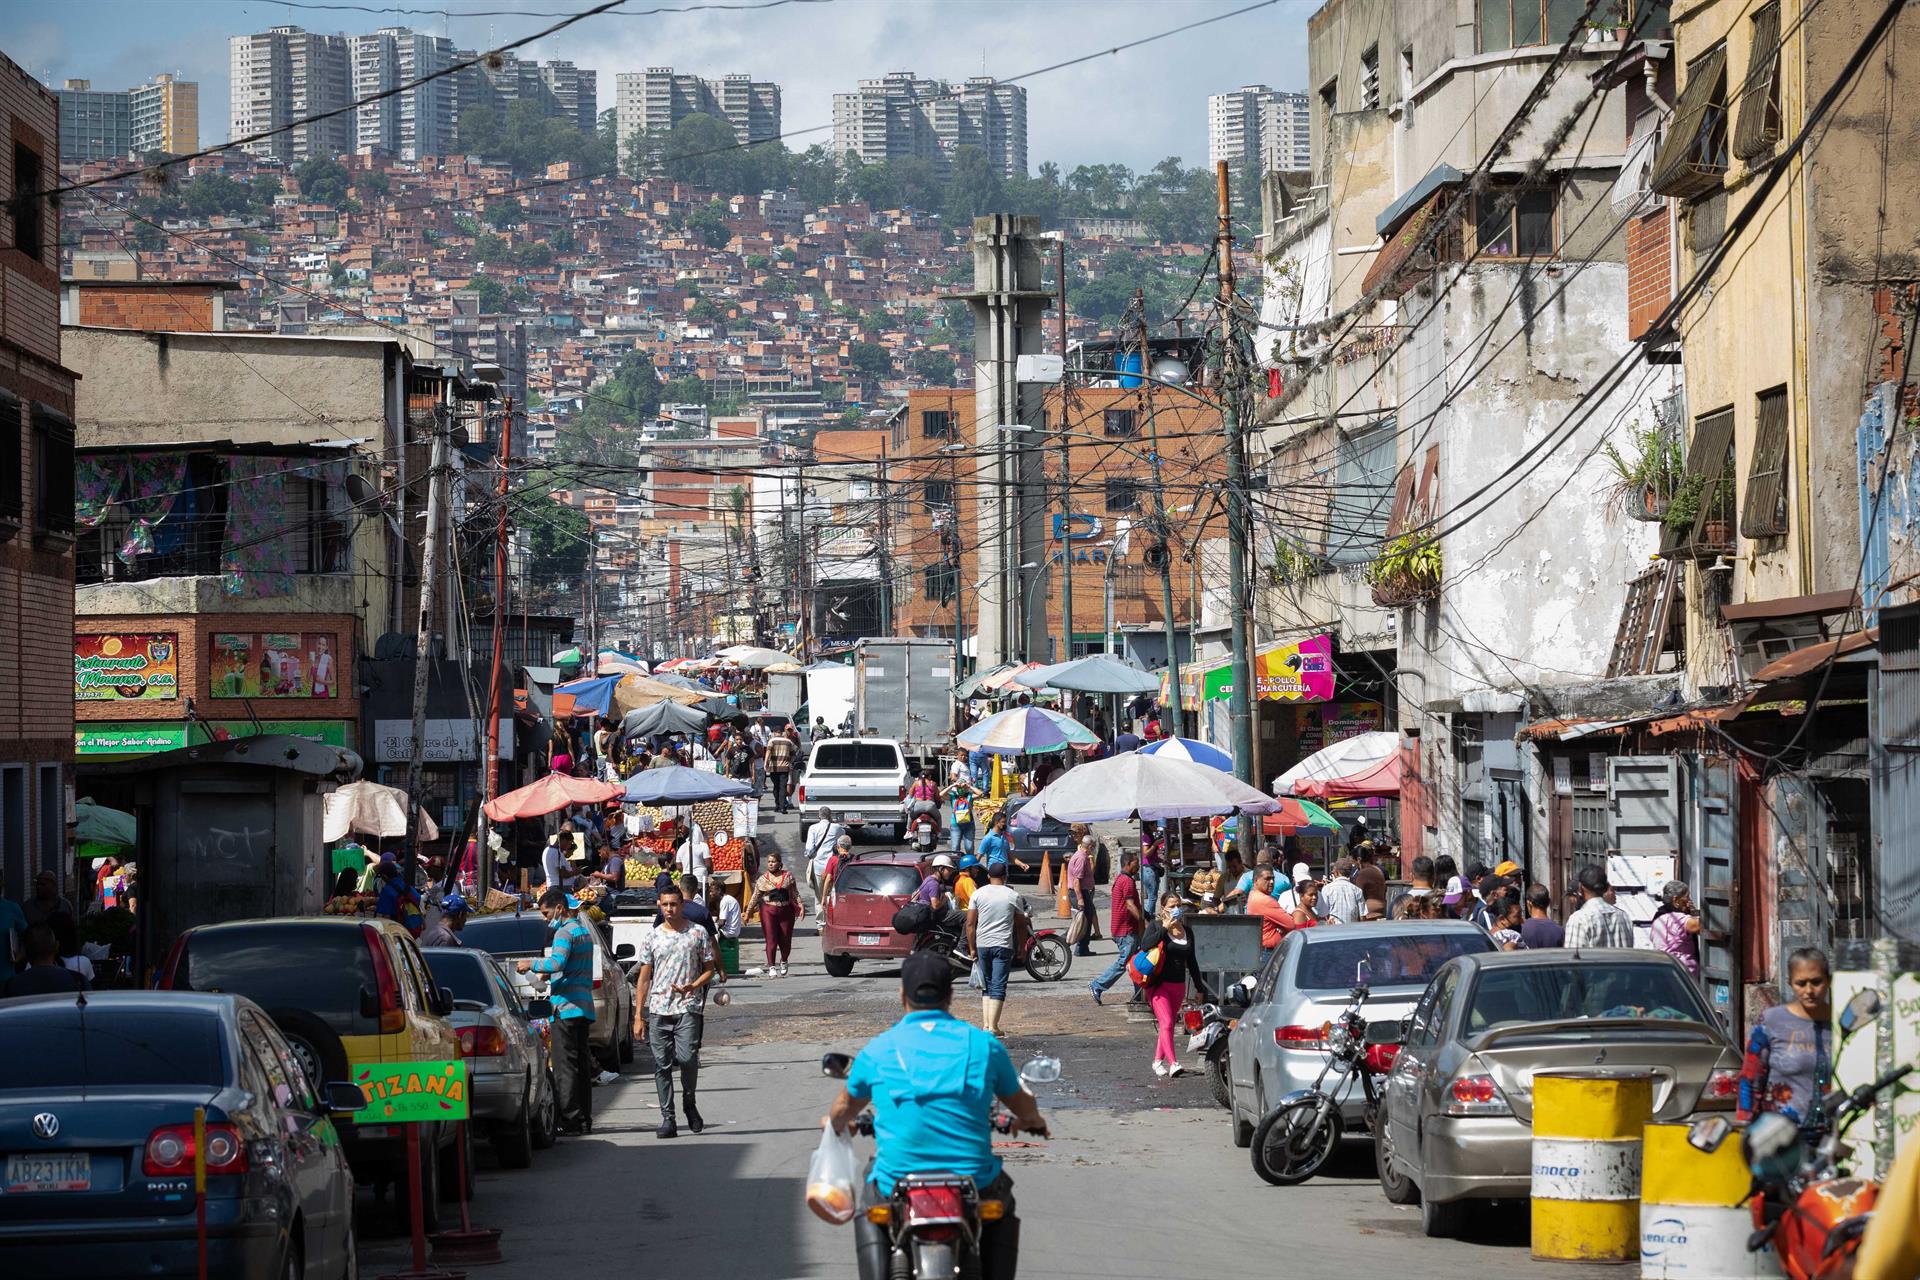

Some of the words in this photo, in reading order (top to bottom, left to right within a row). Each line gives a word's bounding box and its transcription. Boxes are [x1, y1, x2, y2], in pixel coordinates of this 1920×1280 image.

[1270, 676, 1296, 684] POLLO
[88, 738, 95, 746] el
[96, 738, 120, 747] Mejor
[121, 737, 144, 746] Sabor
[145, 737, 172, 745] Andino
[358, 1073, 463, 1102] TIZANA
[147, 1182, 188, 1191] POLO
